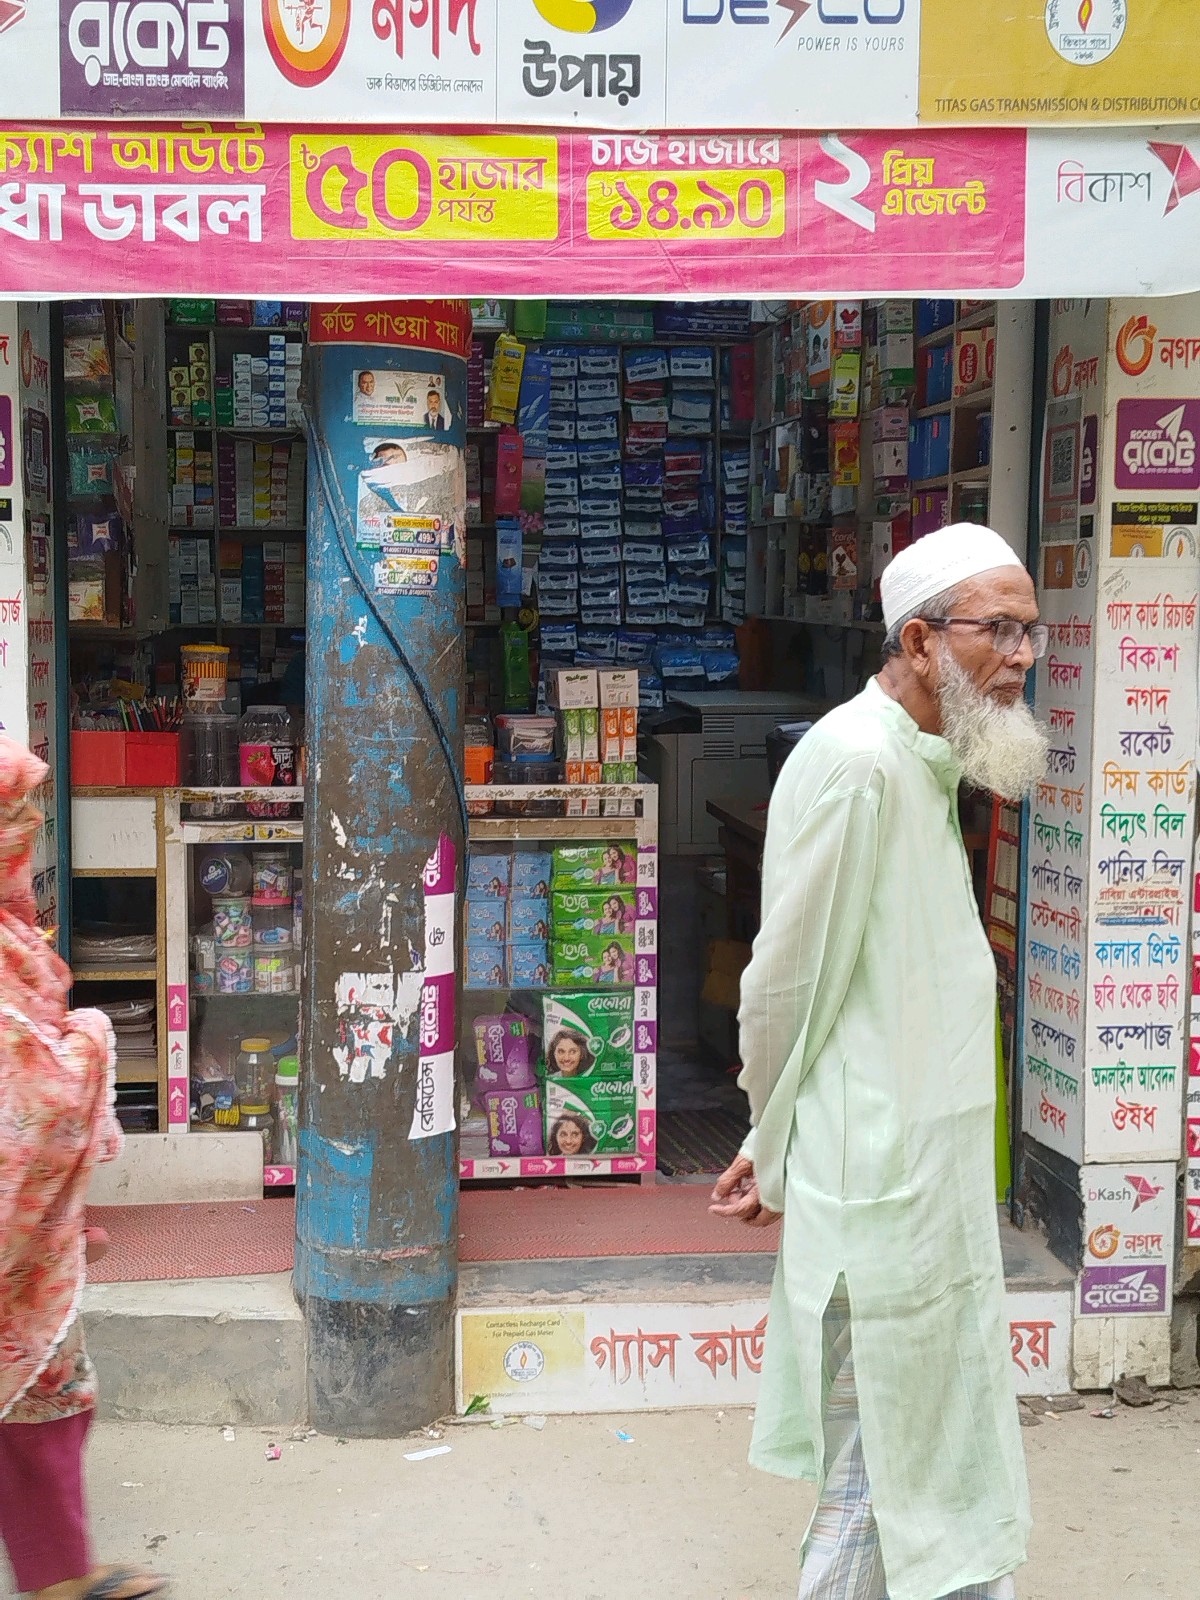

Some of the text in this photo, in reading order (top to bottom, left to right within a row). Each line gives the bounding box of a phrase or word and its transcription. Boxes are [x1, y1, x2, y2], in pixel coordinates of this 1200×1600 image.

[69, 0, 230, 86] রকেট
[797, 37, 906, 51] POWER IS YOURS
[171, 71, 200, 88] মোবাইল
[202, 71, 229, 90] ব্যাংকিং
[366, 73, 483, 93] ডাক বিভাগের ডিজিটাল লেনদেন
[522, 38, 641, 106] উপায়
[934, 99, 968, 112] TITAS
[970, 99, 995, 112] GAS
[998, 98, 1088, 112] TRANSMISSION
[1090, 98, 1100, 111] &
[1103, 97, 1187, 111] DISTRIBUTION
[107, 122, 266, 175] আউটে
[588, 132, 783, 166] চার্জ হাজারে
[437, 157, 547, 191] হাজার
[814, 132, 876, 233] ২
[882, 149, 935, 186] প্রিয়
[1057, 159, 1152, 203] বিকাশ
[79, 183, 266, 242] ডাবল
[437, 192, 497, 223] পর্যন্ত
[882, 181, 987, 216] এজেন্টে
[364, 311, 430, 341] পাওয়া
[1122, 429, 1196, 475] রকেট
[1106, 593, 1198, 632] গ্যাস কার্ড রিচার্জ
[1048, 654, 1082, 691] বিকাশ
[1118, 636, 1181, 673] বিকাশ
[1125, 685, 1171, 716] নগদ
[1049, 707, 1076, 736] নগদ
[1119, 720, 1175, 757] রকেট
[1103, 758, 1192, 798] সিম কার্ড
[1060, 782, 1086, 816] কার্ড
[1064, 820, 1083, 858] বিল
[1100, 802, 1187, 847] বিদ্যুৎ বিল
[1032, 859, 1083, 903] পানির বিল
[1098, 849, 1148, 885] পানির
[559, 894, 589, 912] Joya
[558, 942, 589, 960] Joya
[1029, 940, 1058, 975] কালার
[1094, 932, 1182, 970] কালার প্রিন্ট
[1093, 973, 1181, 1012] ছবি থেকে ছবি
[1030, 1016, 1077, 1063] কম্পোজ
[1096, 1021, 1174, 1051] কম্পোজ
[1091, 1058, 1177, 1094] অনলাইন আবেদন
[1111, 1095, 1158, 1132] ঔষধ
[1088, 1188, 1131, 1201] bKash
[1123, 1234, 1163, 1253] নগদ
[1084, 1282, 1160, 1309] রকেট
[503, 1330, 525, 1339] Prepaid
[526, 1330, 536, 1338] Gas
[520, 1320, 546, 1329] Recharge
[547, 1319, 561, 1327] Card
[589, 1327, 682, 1385] গ্যাস
[689, 1313, 769, 1381] কার্ড
